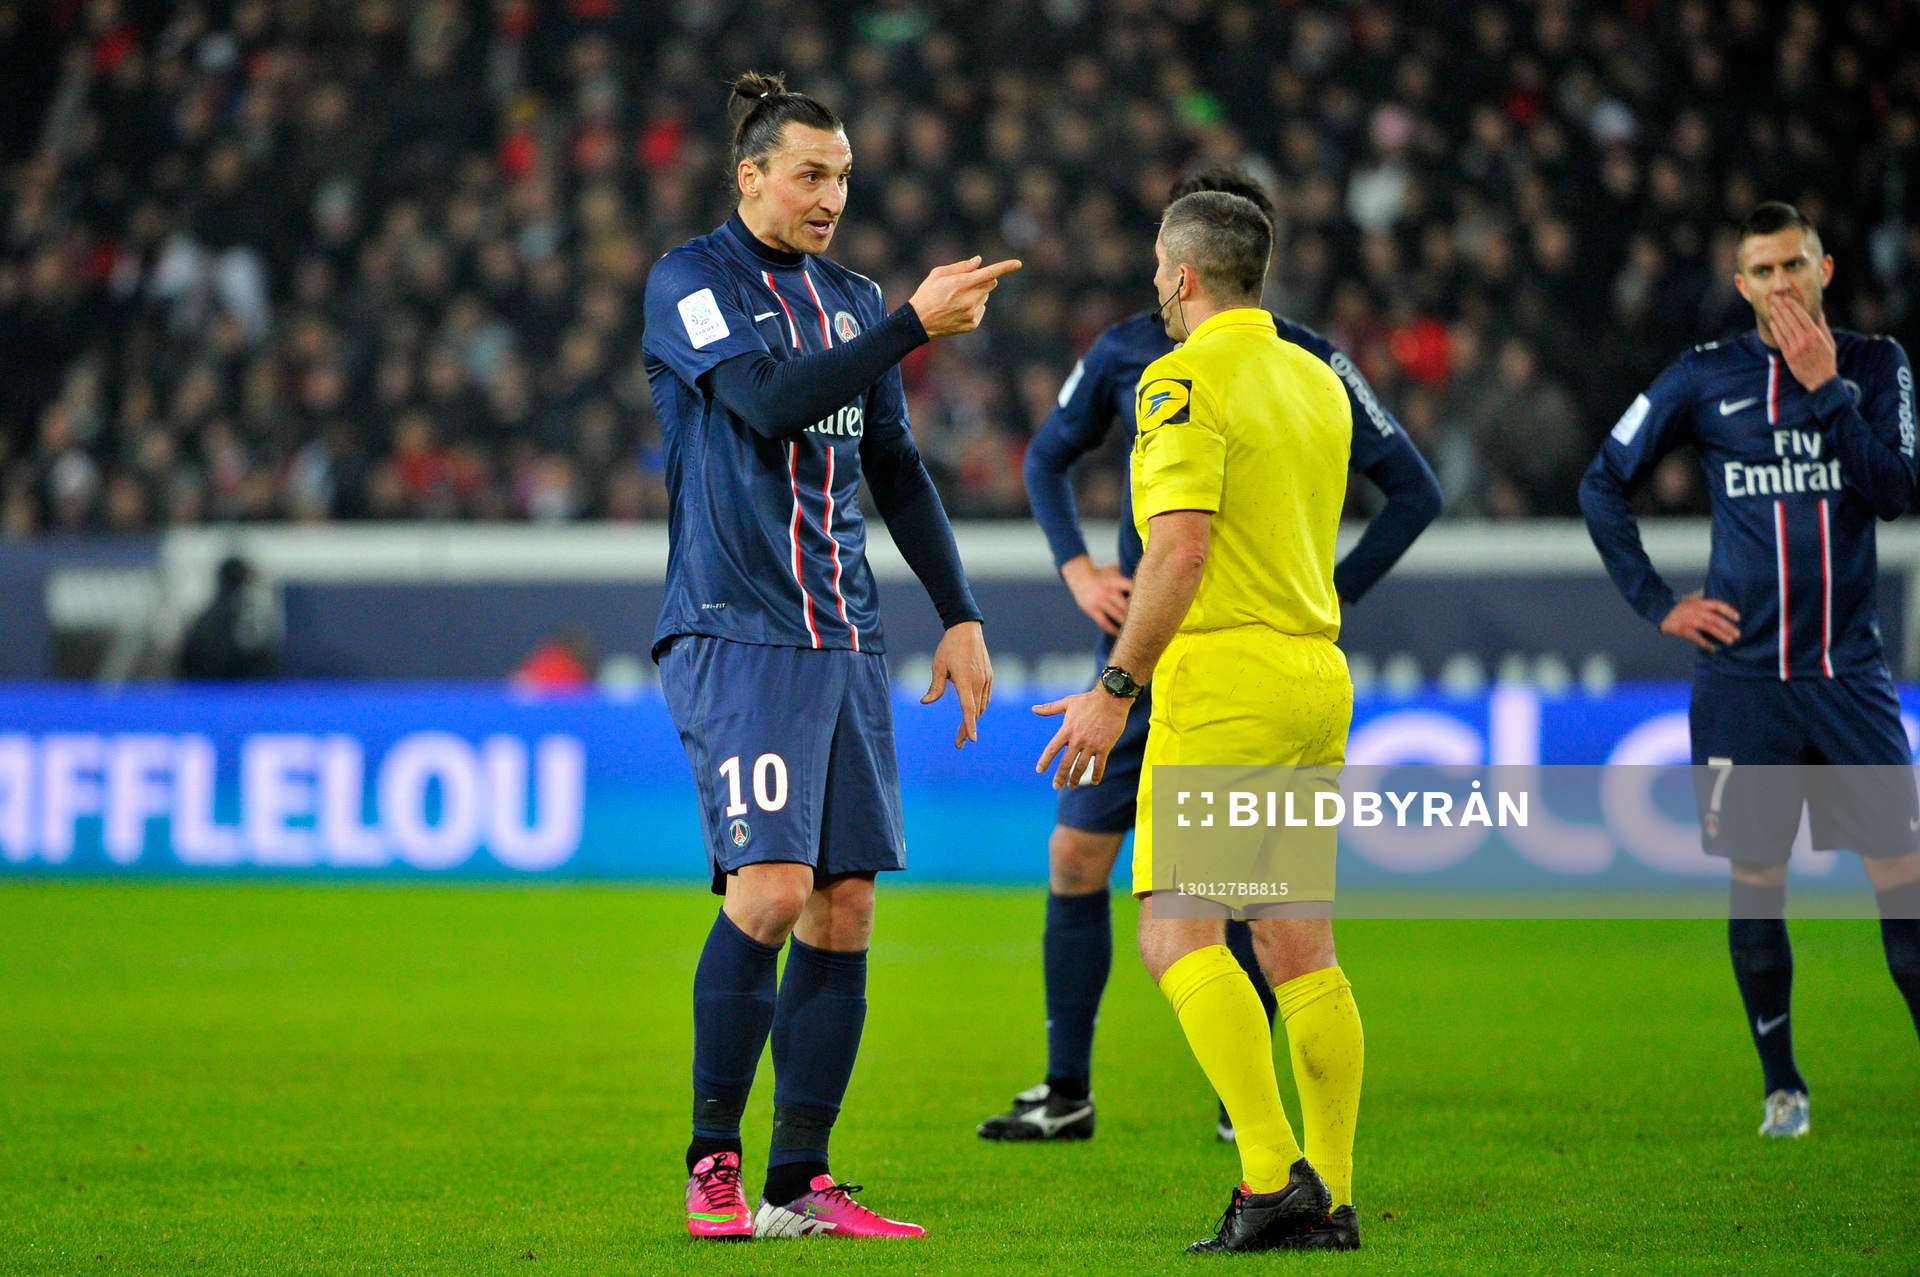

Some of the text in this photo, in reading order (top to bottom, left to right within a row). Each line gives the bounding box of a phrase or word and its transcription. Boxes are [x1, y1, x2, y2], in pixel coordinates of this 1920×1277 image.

[1774, 429, 1822, 459] Fly
[718, 752, 789, 817] 10
[1707, 756, 1733, 812] 7
